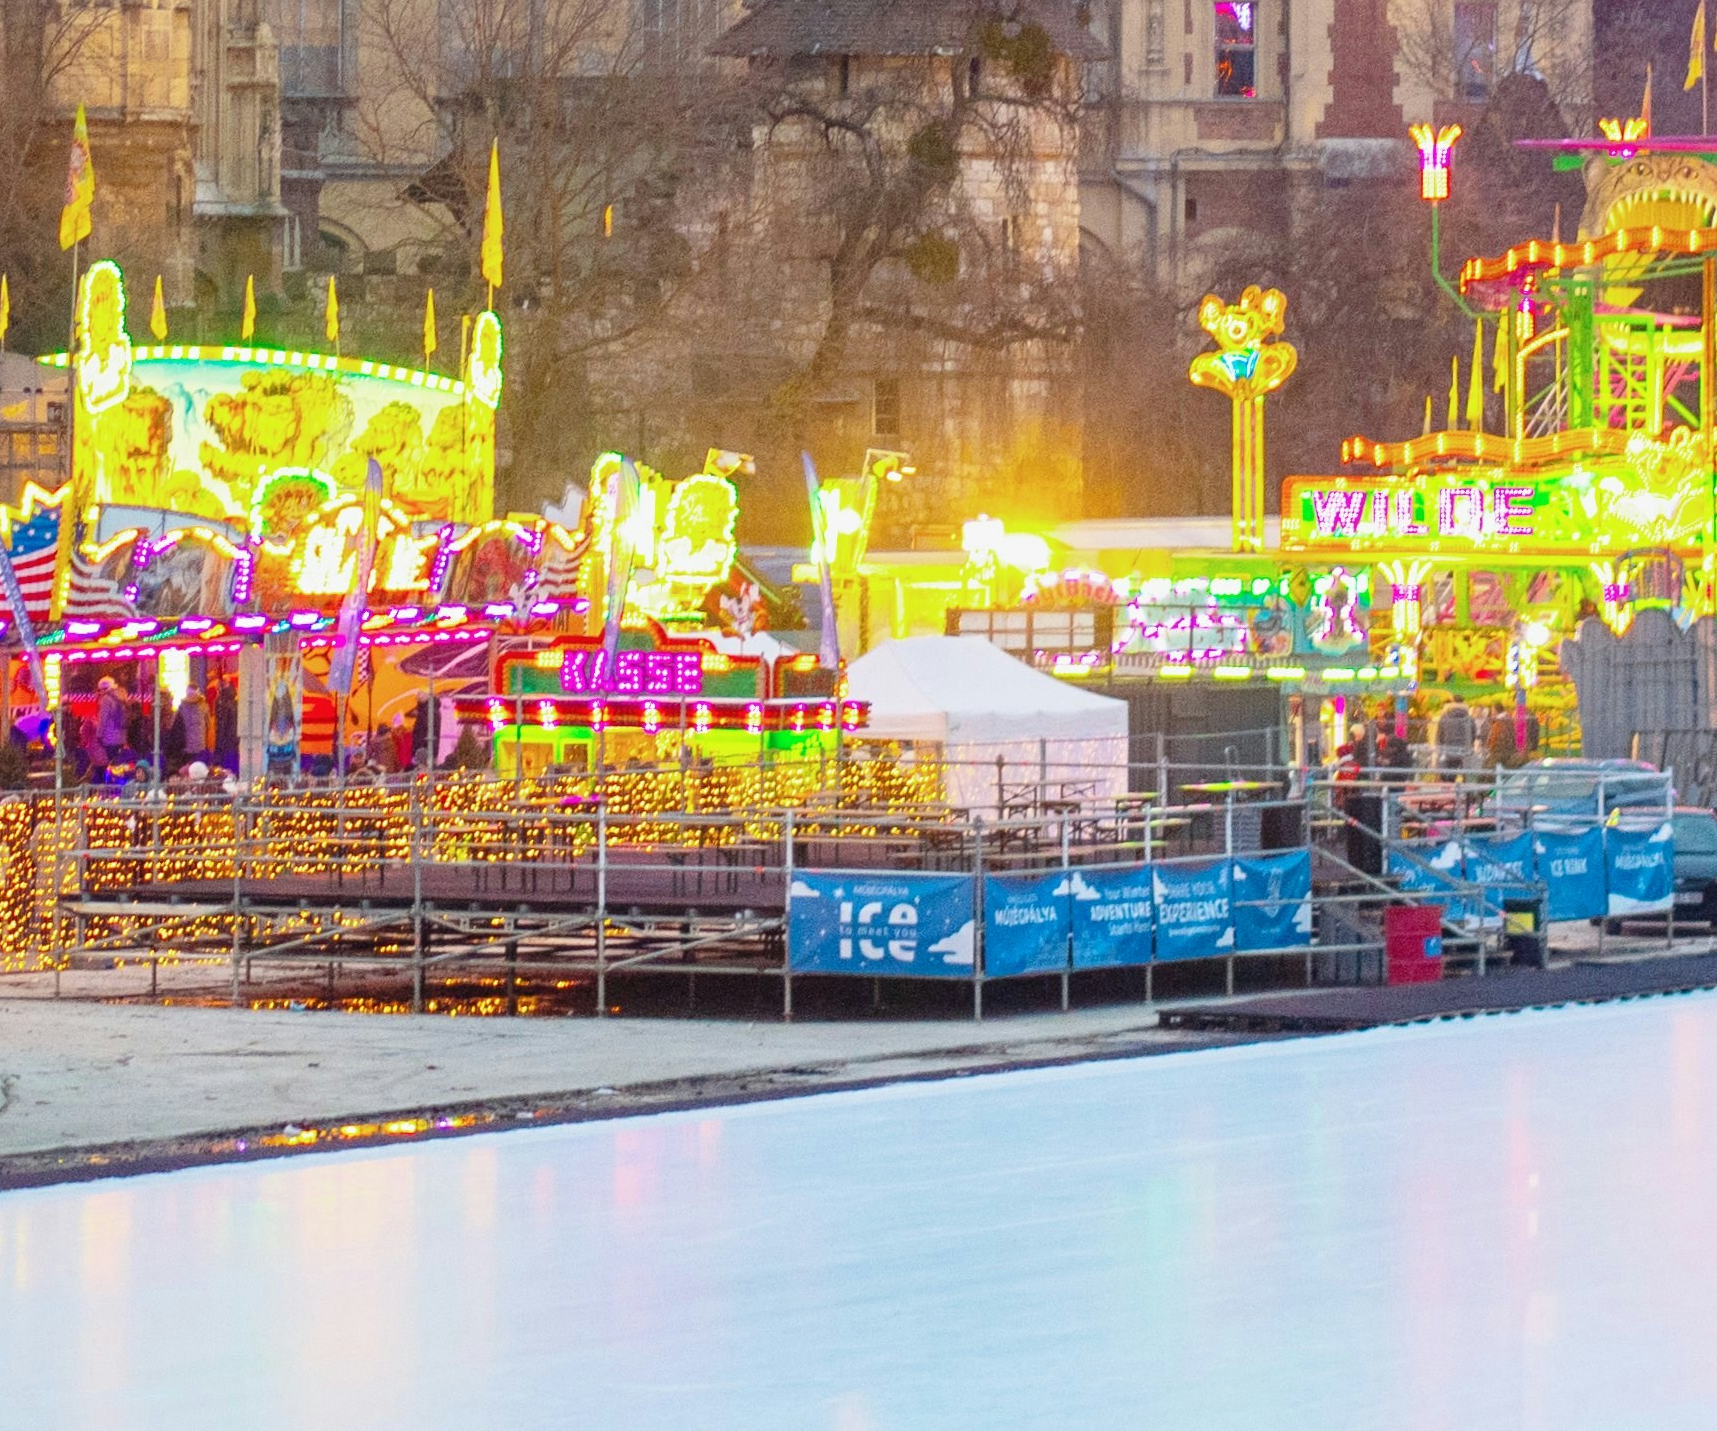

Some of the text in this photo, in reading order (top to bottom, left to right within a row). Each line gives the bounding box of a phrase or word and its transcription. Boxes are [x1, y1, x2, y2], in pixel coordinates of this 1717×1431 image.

[1312, 487, 1535, 536] WILDE
[560, 649, 703, 693] KASSE
[1090, 901, 1152, 922] ADVENTURE
[1159, 898, 1230, 924] EXPERIENCE
